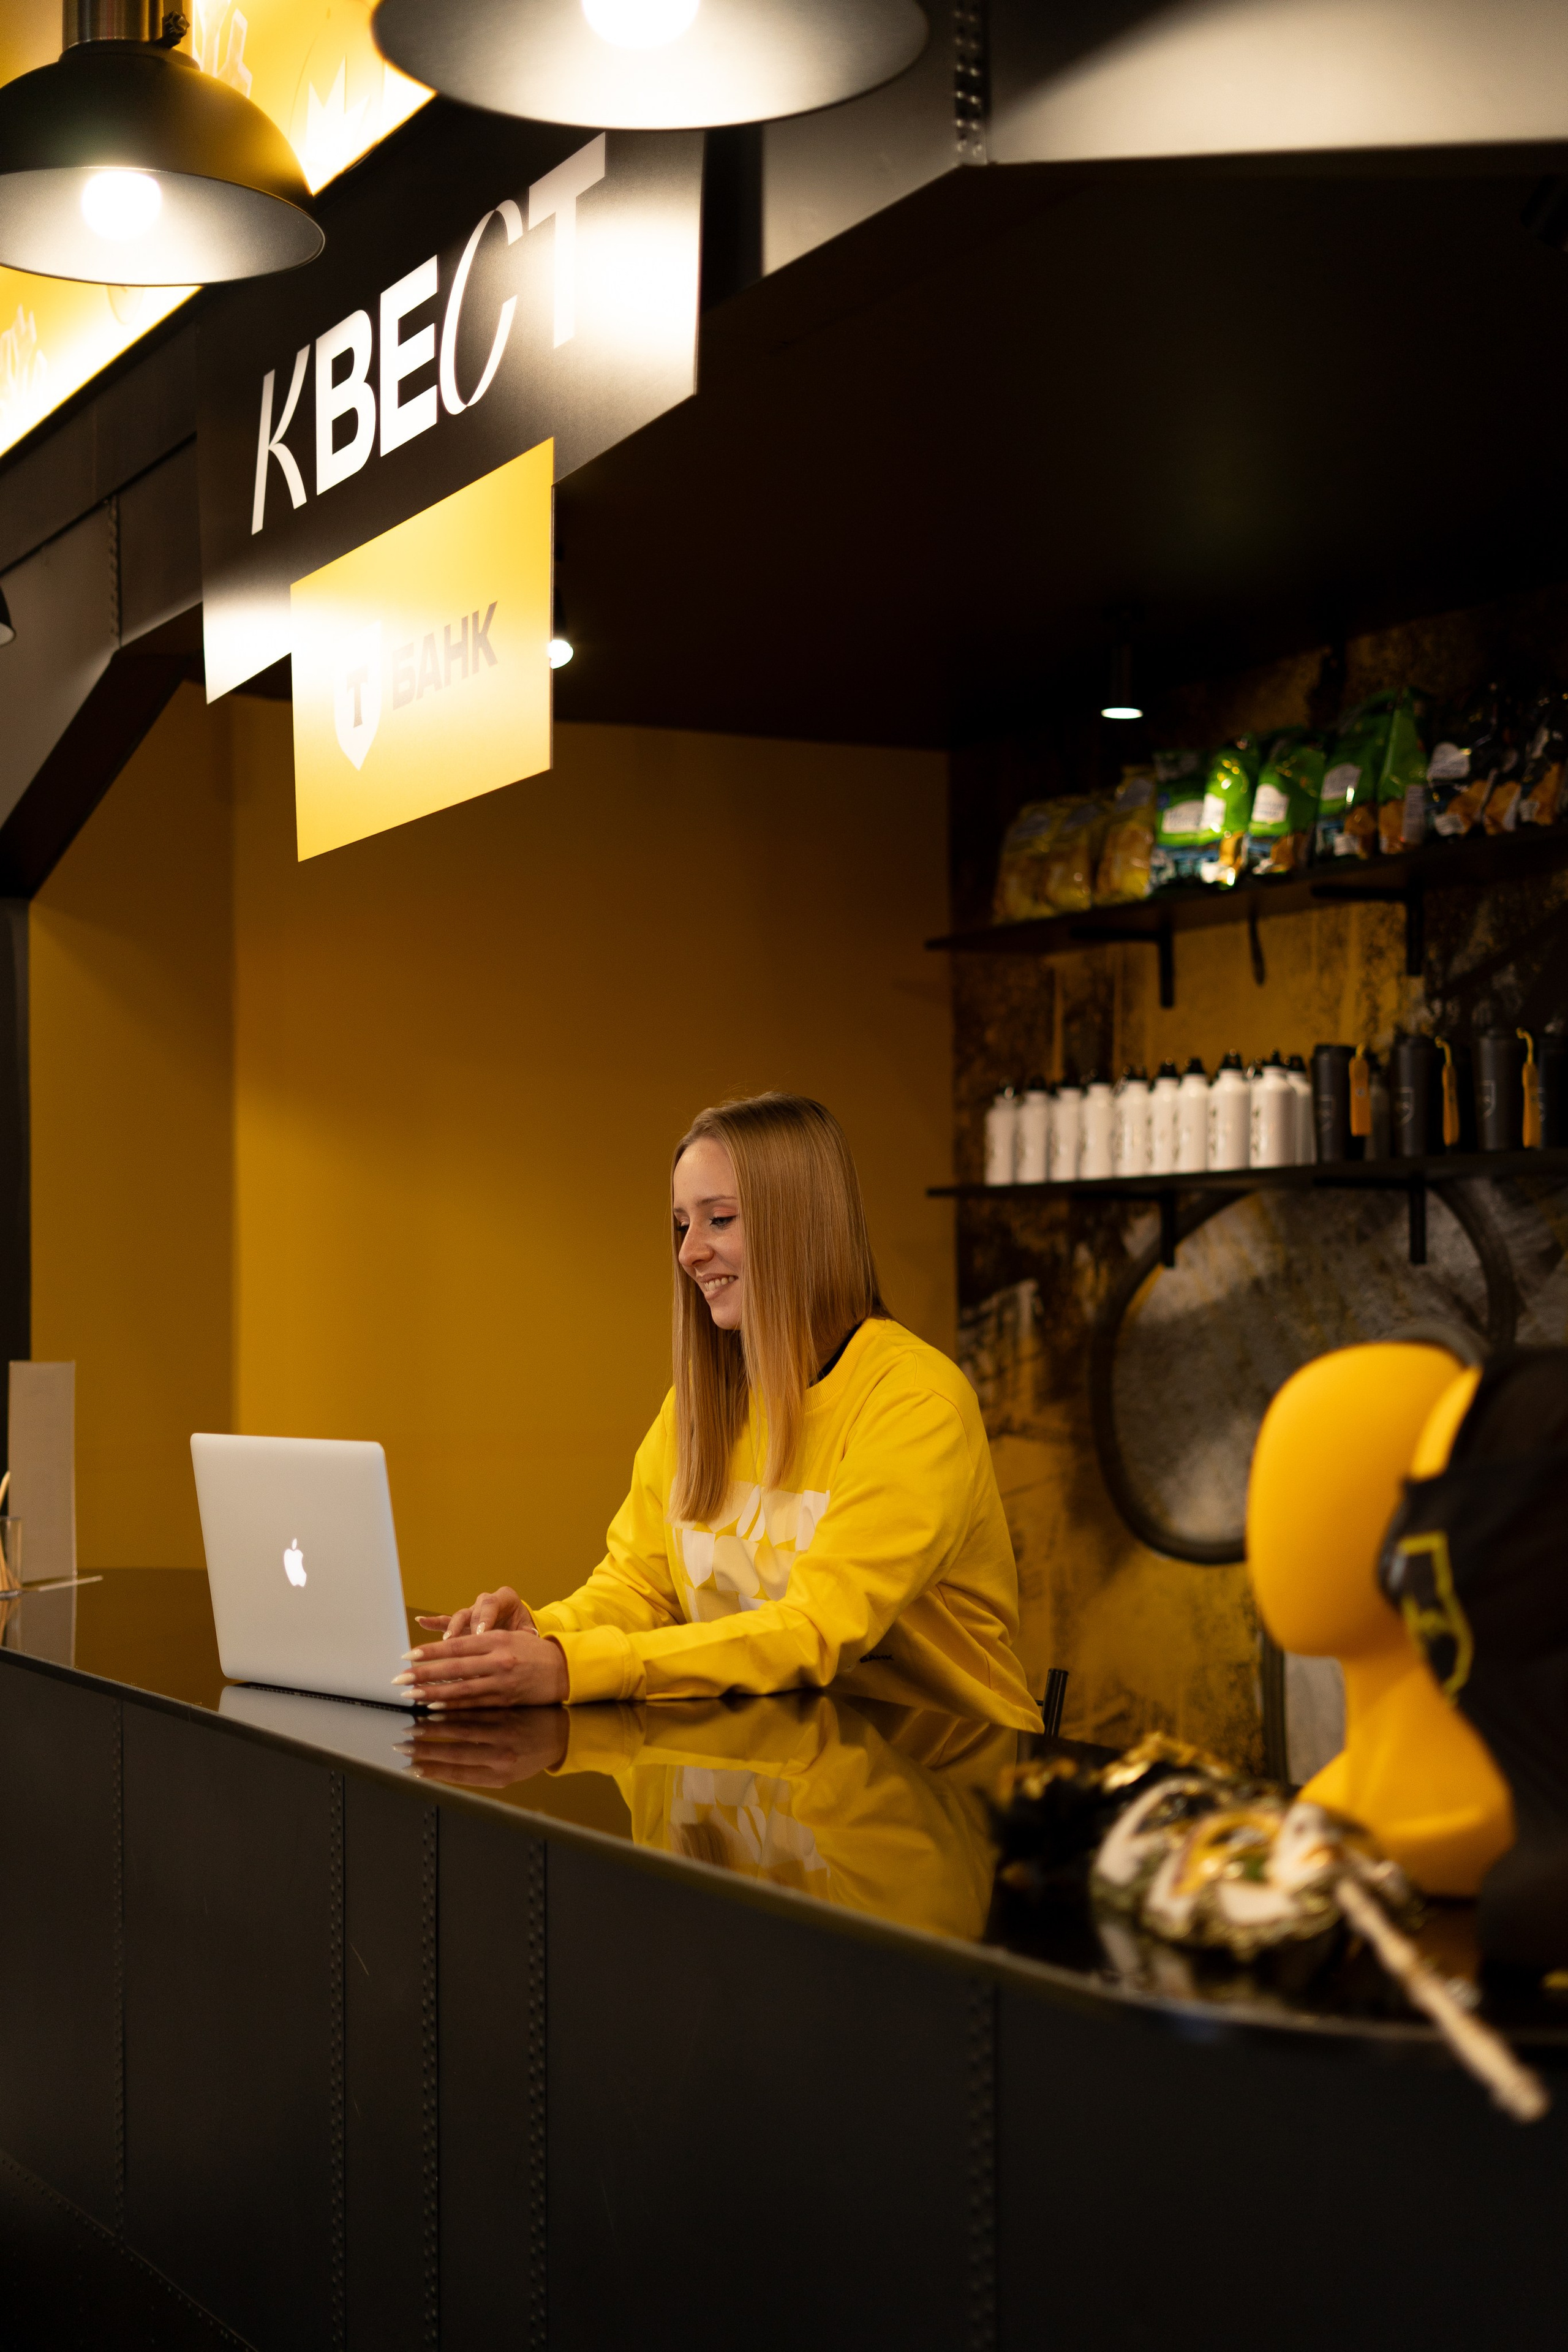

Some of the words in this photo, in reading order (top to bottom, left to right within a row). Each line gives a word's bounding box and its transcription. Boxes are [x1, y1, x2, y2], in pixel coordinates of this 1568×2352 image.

[251, 132, 606, 535] КВЕСТ
[392, 600, 499, 711] БАНК
[859, 1654, 894, 1663] БАНК
